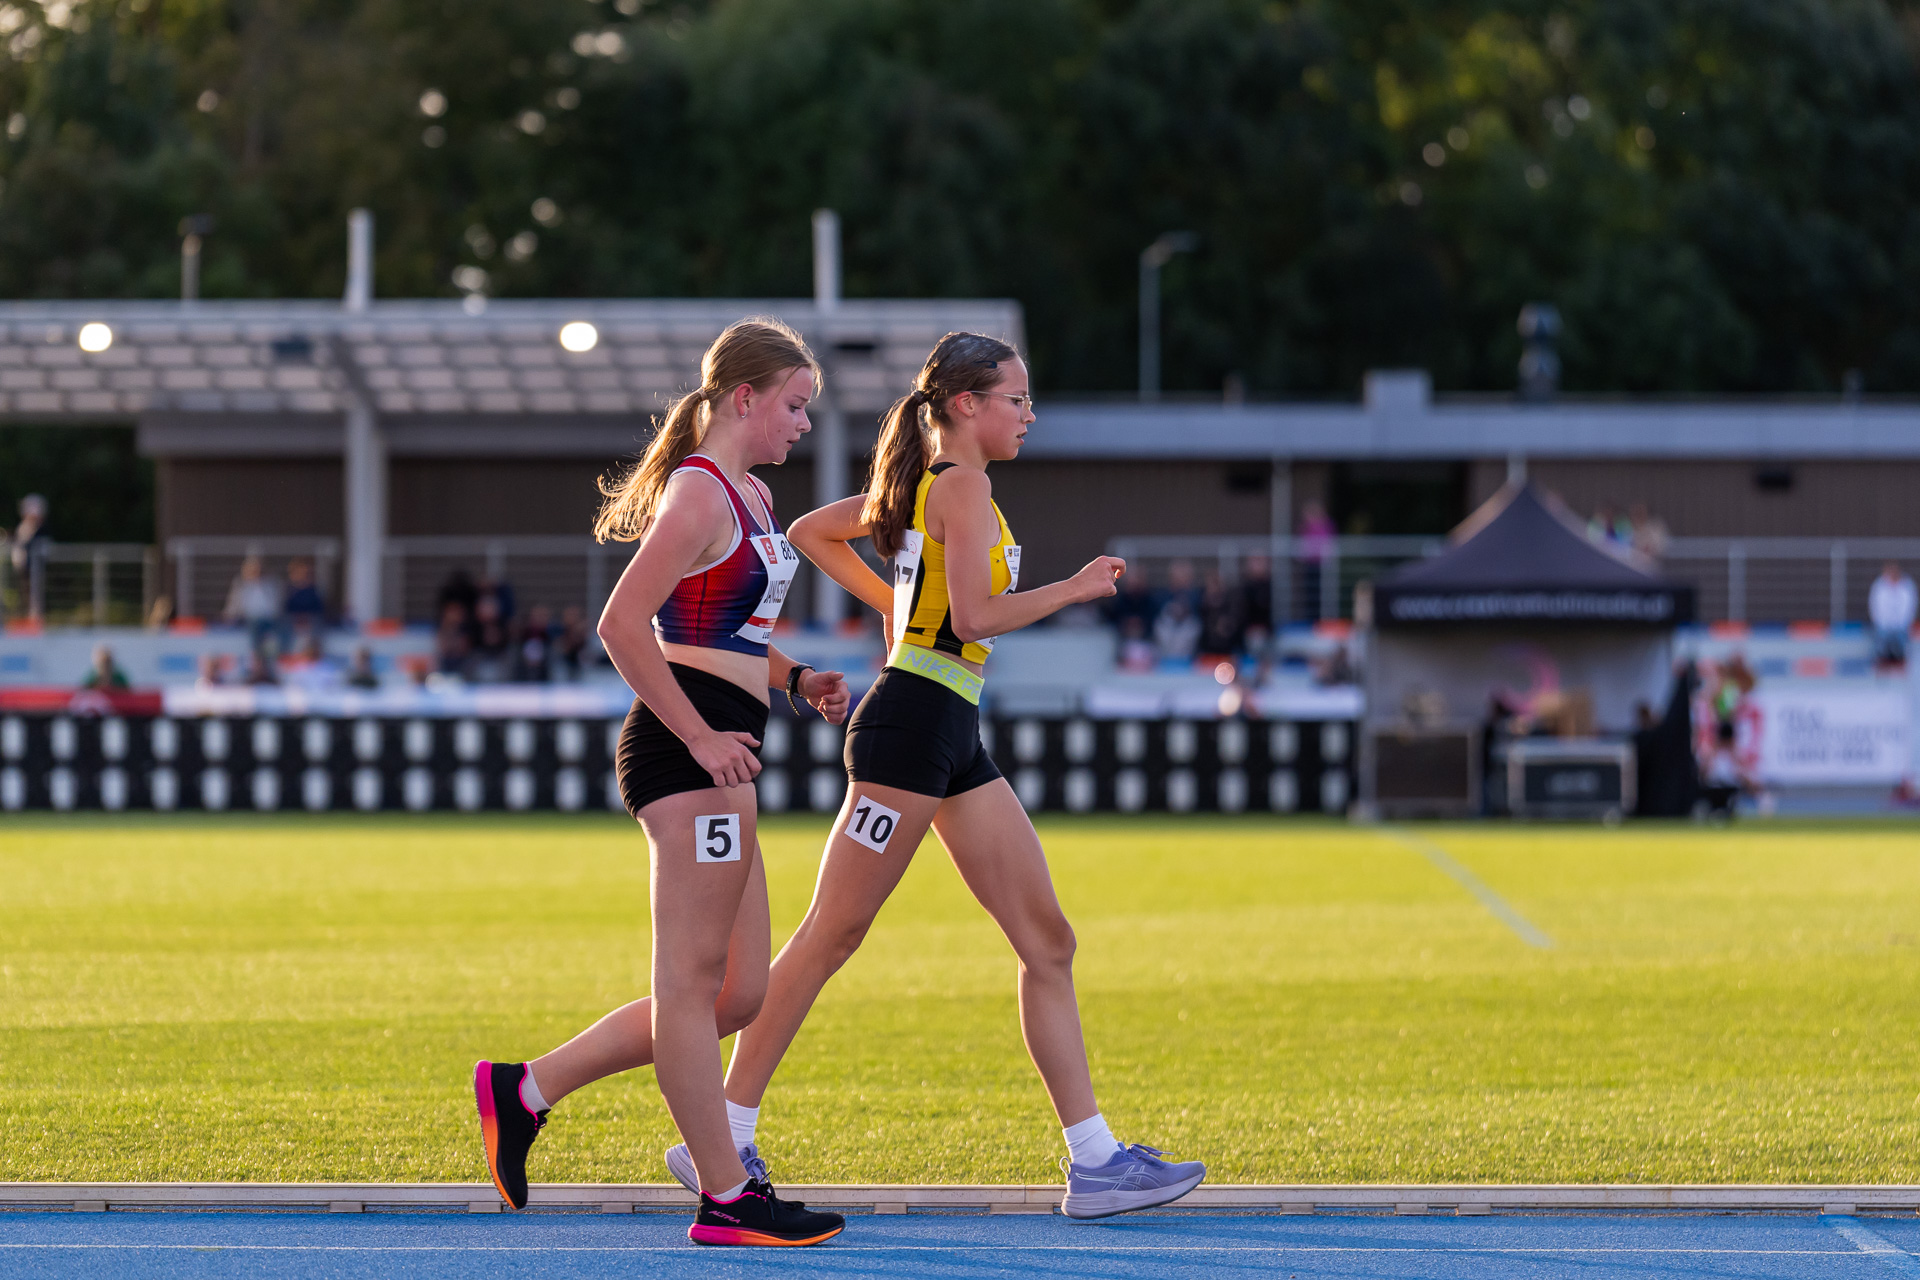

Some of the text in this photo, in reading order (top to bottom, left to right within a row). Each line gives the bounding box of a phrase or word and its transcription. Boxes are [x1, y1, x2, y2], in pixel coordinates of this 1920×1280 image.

[902, 650, 964, 686] NIKE
[706, 817, 732, 859] 5
[855, 805, 894, 844] 10
[708, 1210, 741, 1224] ALTRA
